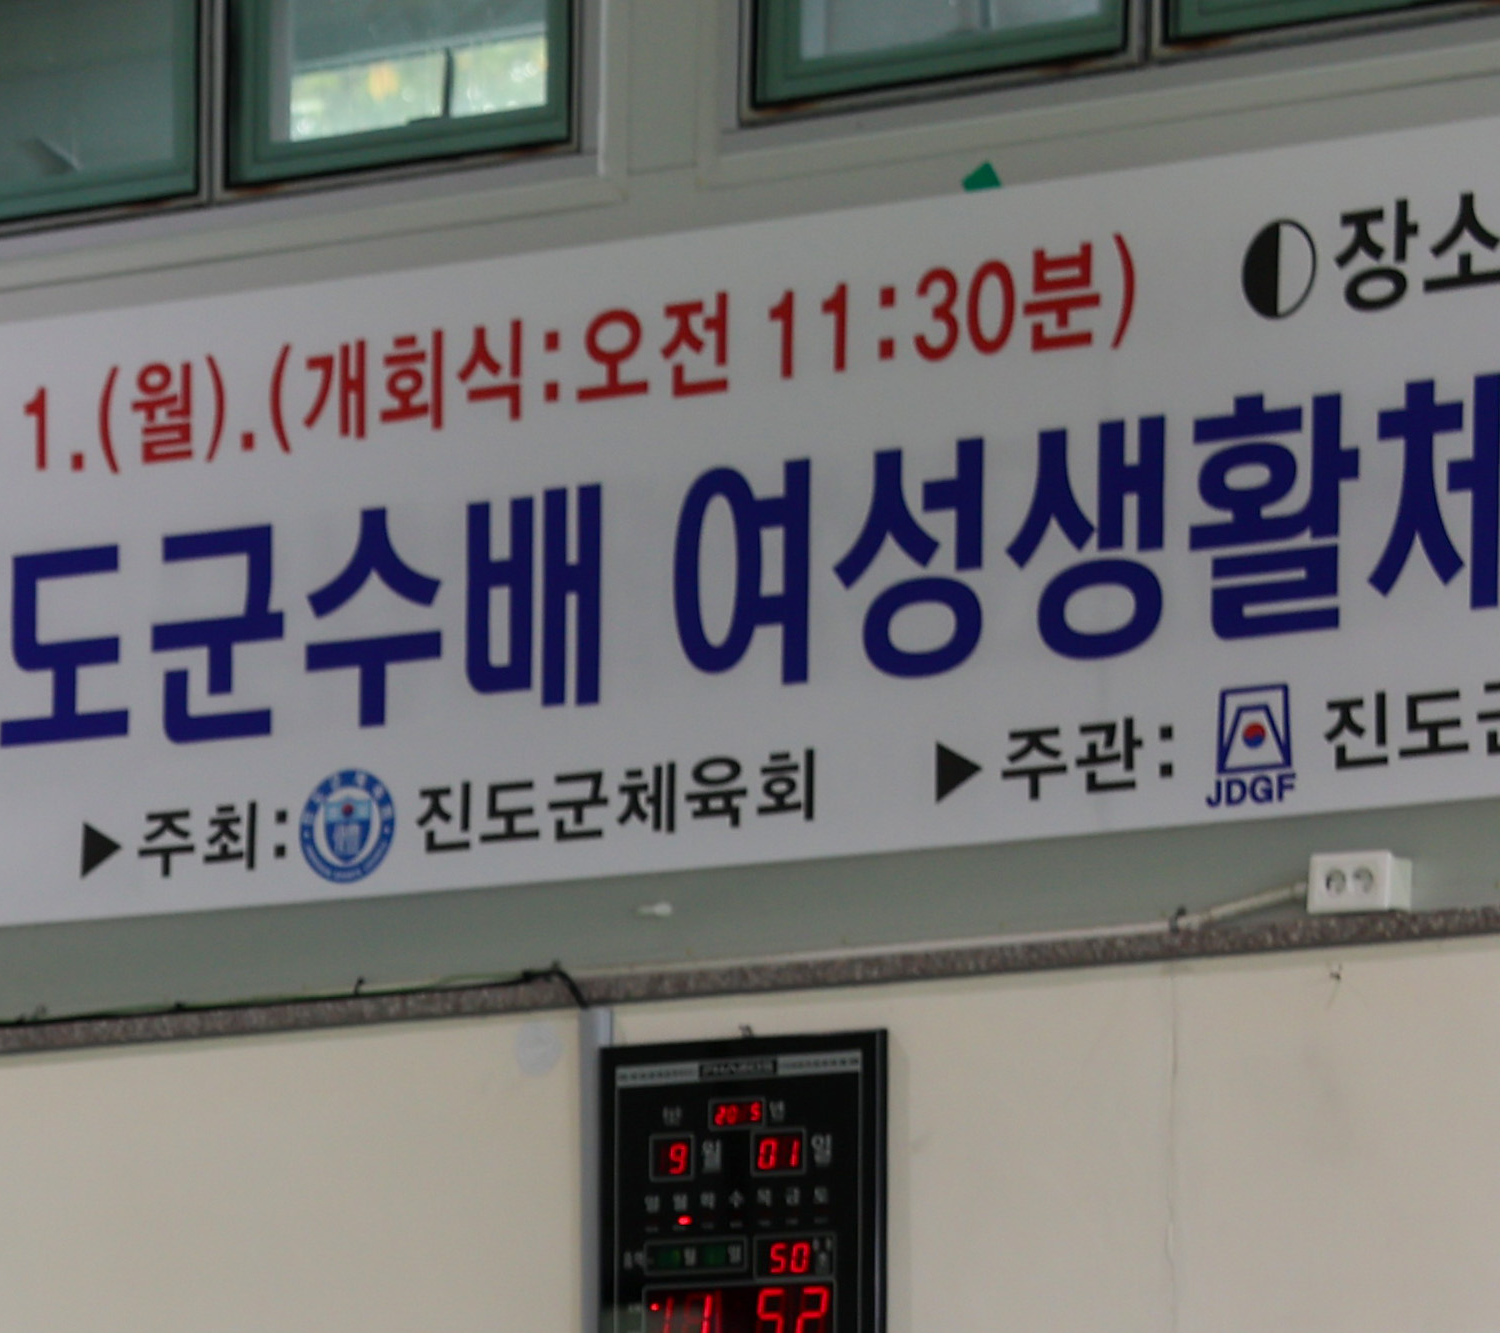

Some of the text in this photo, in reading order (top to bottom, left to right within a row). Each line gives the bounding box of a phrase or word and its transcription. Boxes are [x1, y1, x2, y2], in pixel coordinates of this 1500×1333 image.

[769, 234, 1136, 379] 11:30분)
[1001, 716, 1174, 804] 주관:
[1205, 772, 1298, 808] JDGF
[137, 801, 290, 878] 주최:
[416, 747, 816, 855] 진도군체육회
[756, 1135, 802, 1171] 01
[768, 1239, 813, 1276] 50
